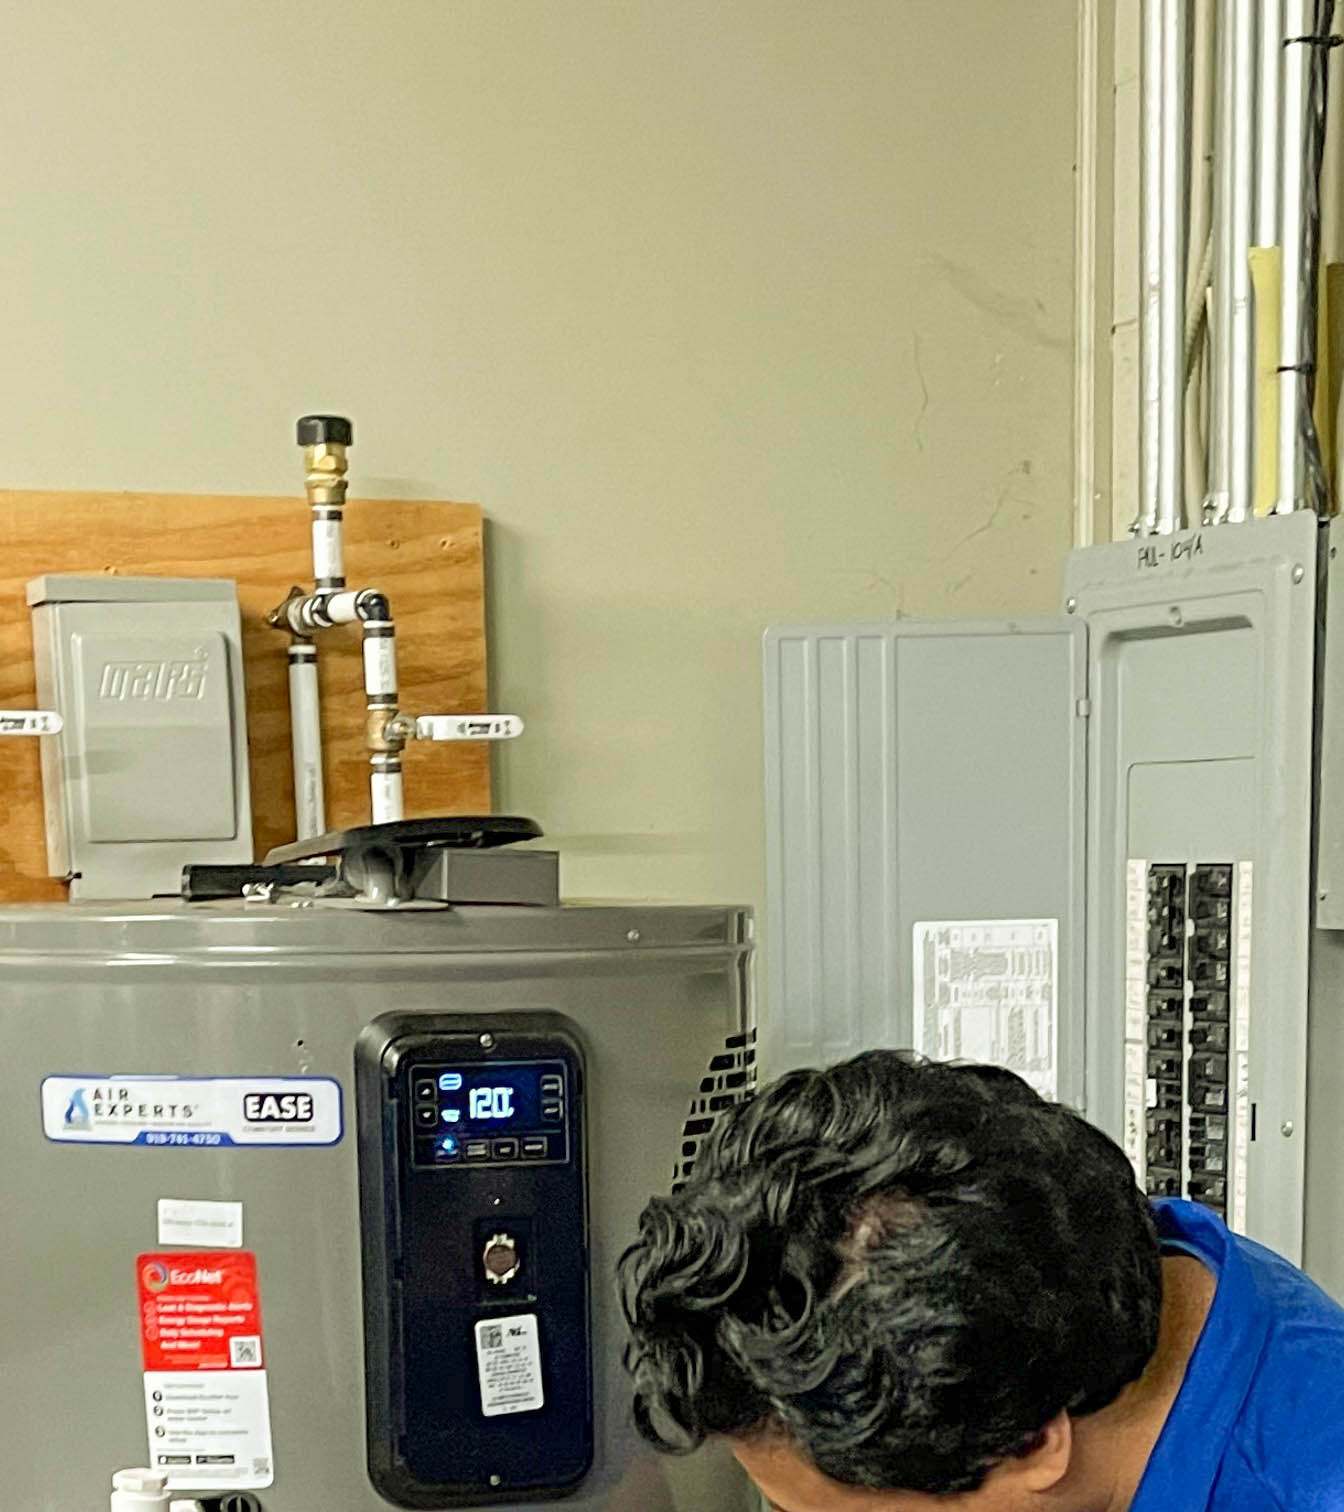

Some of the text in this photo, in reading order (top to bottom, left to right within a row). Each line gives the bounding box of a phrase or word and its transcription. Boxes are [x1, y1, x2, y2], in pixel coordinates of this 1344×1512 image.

[93, 1088, 129, 1101] AIR
[94, 1103, 194, 1119] EXPERTS
[246, 1095, 312, 1120] EASE
